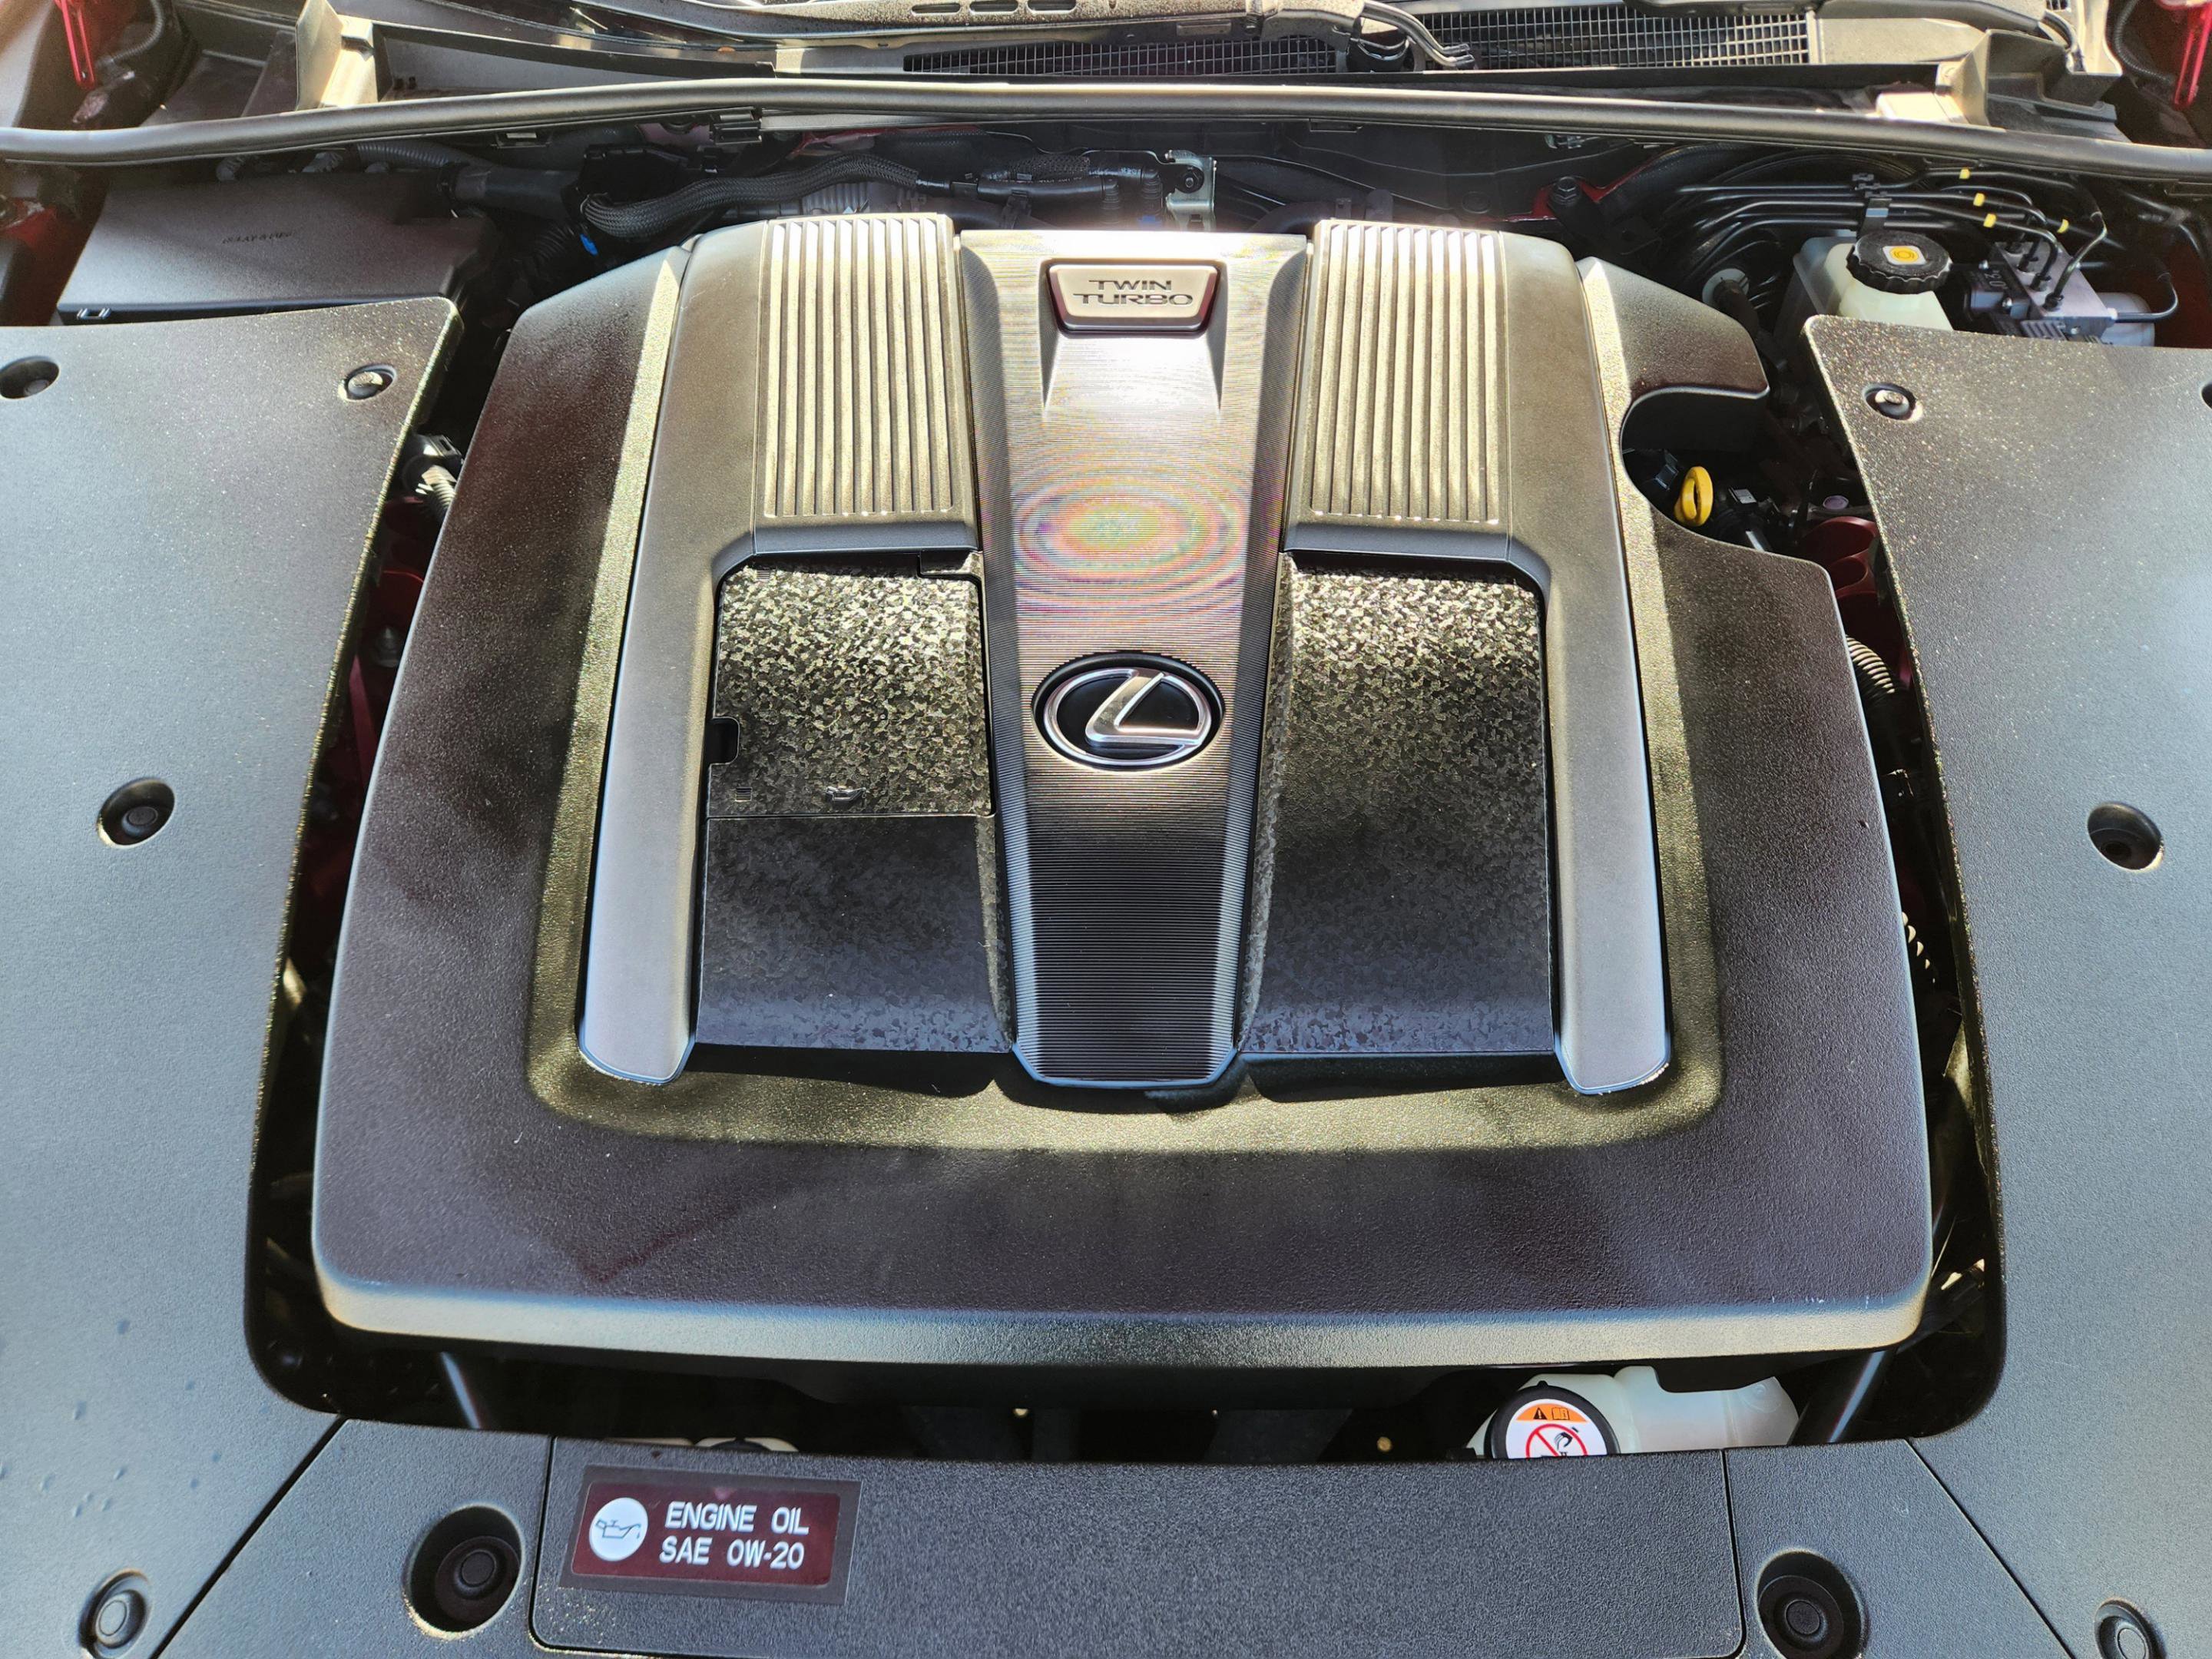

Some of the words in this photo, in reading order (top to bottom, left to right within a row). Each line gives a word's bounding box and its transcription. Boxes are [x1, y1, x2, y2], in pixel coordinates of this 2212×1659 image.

[1088, 280, 1171, 290] TWIN
[1072, 293, 1193, 305] TURBO
[664, 1501, 757, 1532] ENGINE
[770, 1506, 810, 1536] OIL
[658, 1535, 713, 1565] SAE
[726, 1538, 805, 1571] 0W-20
